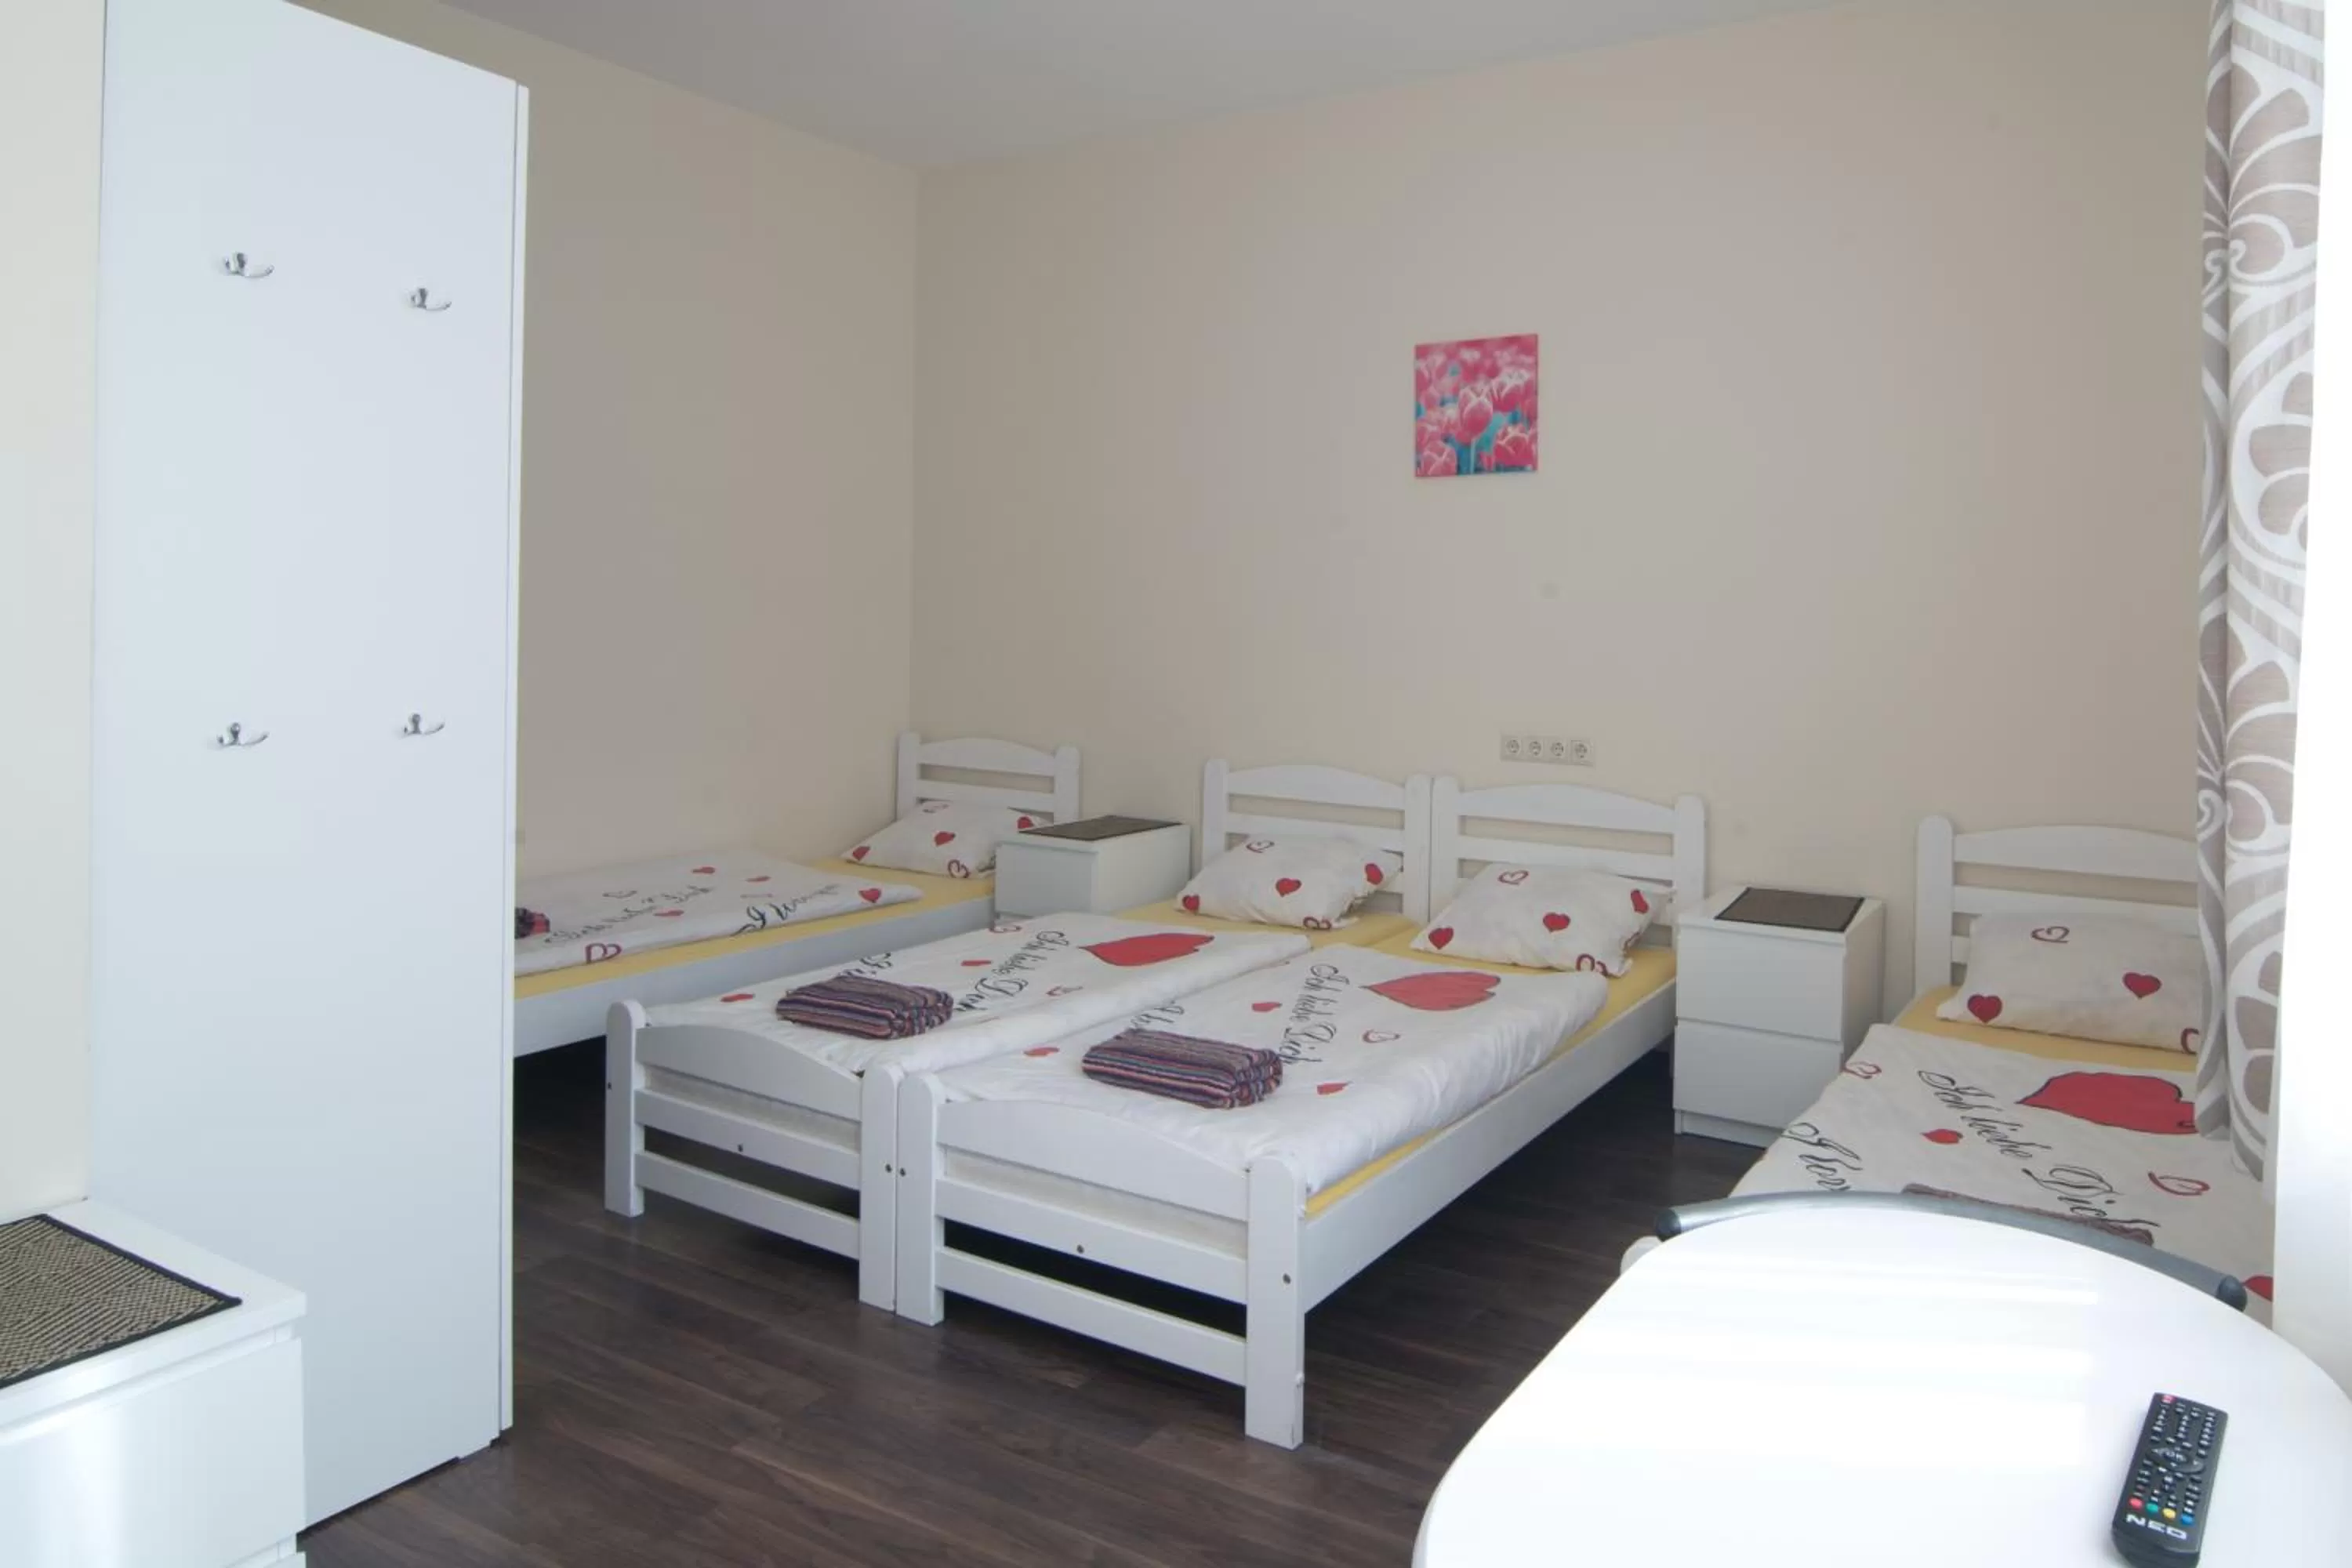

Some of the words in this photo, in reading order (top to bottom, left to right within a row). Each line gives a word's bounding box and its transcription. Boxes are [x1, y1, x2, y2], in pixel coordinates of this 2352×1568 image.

[1305, 964, 1350, 992] Ich
[1917, 1069, 2004, 1112] Ich
[1960, 1115, 2052, 1160] liebe
